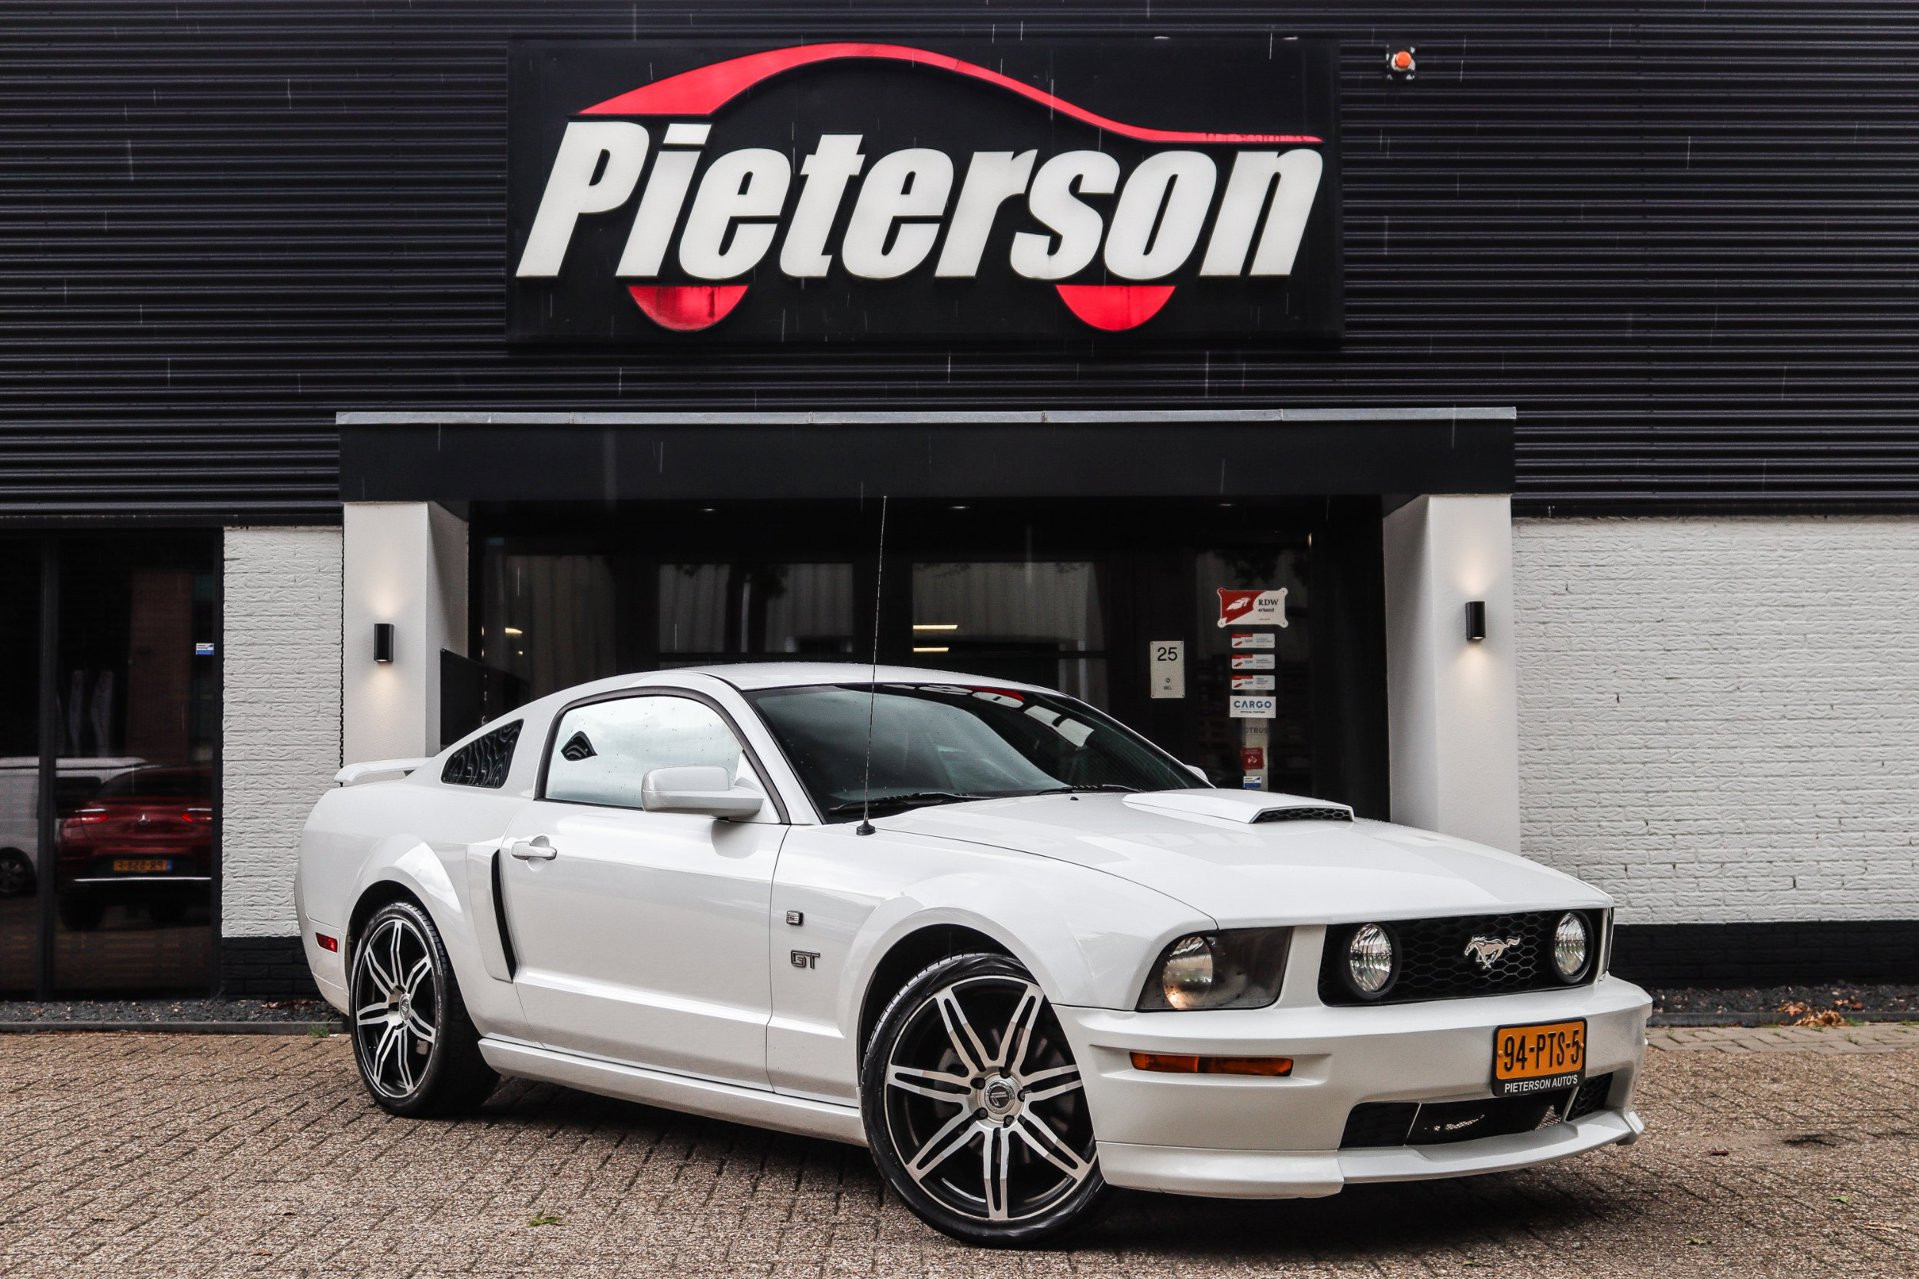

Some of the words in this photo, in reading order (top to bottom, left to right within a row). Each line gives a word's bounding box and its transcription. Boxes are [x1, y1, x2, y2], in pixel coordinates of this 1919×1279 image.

[516, 122, 1323, 280] Pieterson
[1157, 646, 1178, 661] 25
[1233, 700, 1272, 709] CARGO
[790, 949, 821, 970] GT
[1503, 1029, 1580, 1073] 94-PTS-5
[1504, 1079, 1551, 1094] PIETERSON
[1551, 1074, 1578, 1088] AUTO'S
